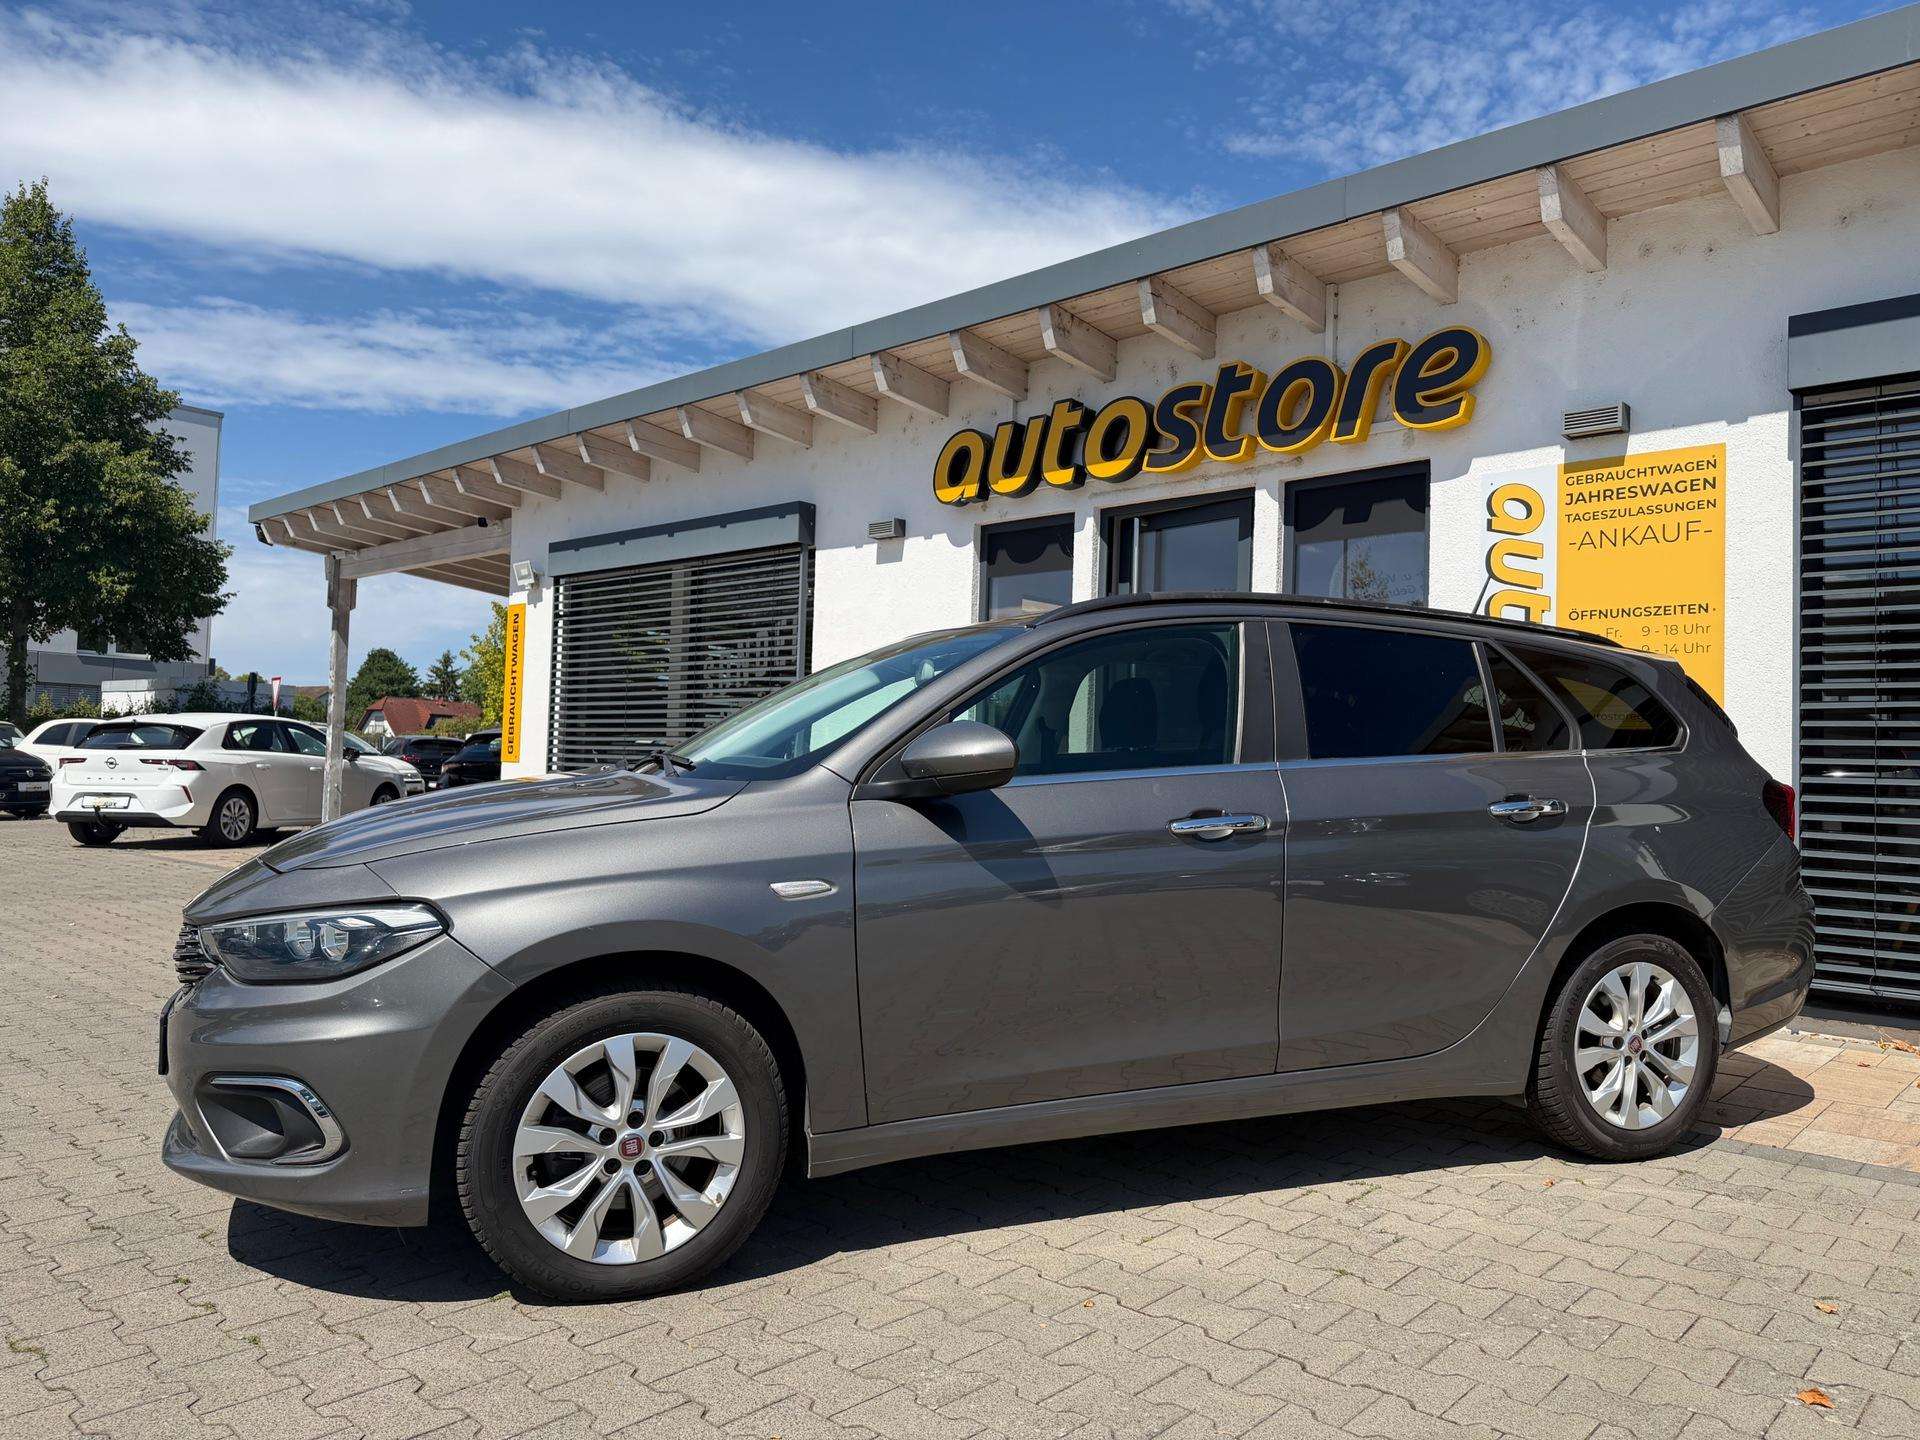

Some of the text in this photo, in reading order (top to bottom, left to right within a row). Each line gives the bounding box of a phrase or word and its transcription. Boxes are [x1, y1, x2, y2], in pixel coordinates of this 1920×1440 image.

[933, 325, 1492, 506] autostore
[1565, 458, 1717, 487] GEBRAUCHTWAGEN
[1565, 476, 1717, 506] JAHRESWAGEN
[1565, 498, 1717, 523] TAGESZULASSUNGEN
[1569, 519, 1713, 551] -ANKAUF-
[1568, 602, 1709, 621] ÖFFNUNGSZEITEN
[1606, 627, 1623, 638] Fr.
[1641, 625, 1650, 637] 9
[1663, 624, 1679, 636] 18
[1684, 623, 1712, 636] Uhr
[1663, 643, 1679, 655] 14
[1684, 642, 1712, 655] Uhr
[507, 613, 519, 754] GEBRAUCHTWAGEN
